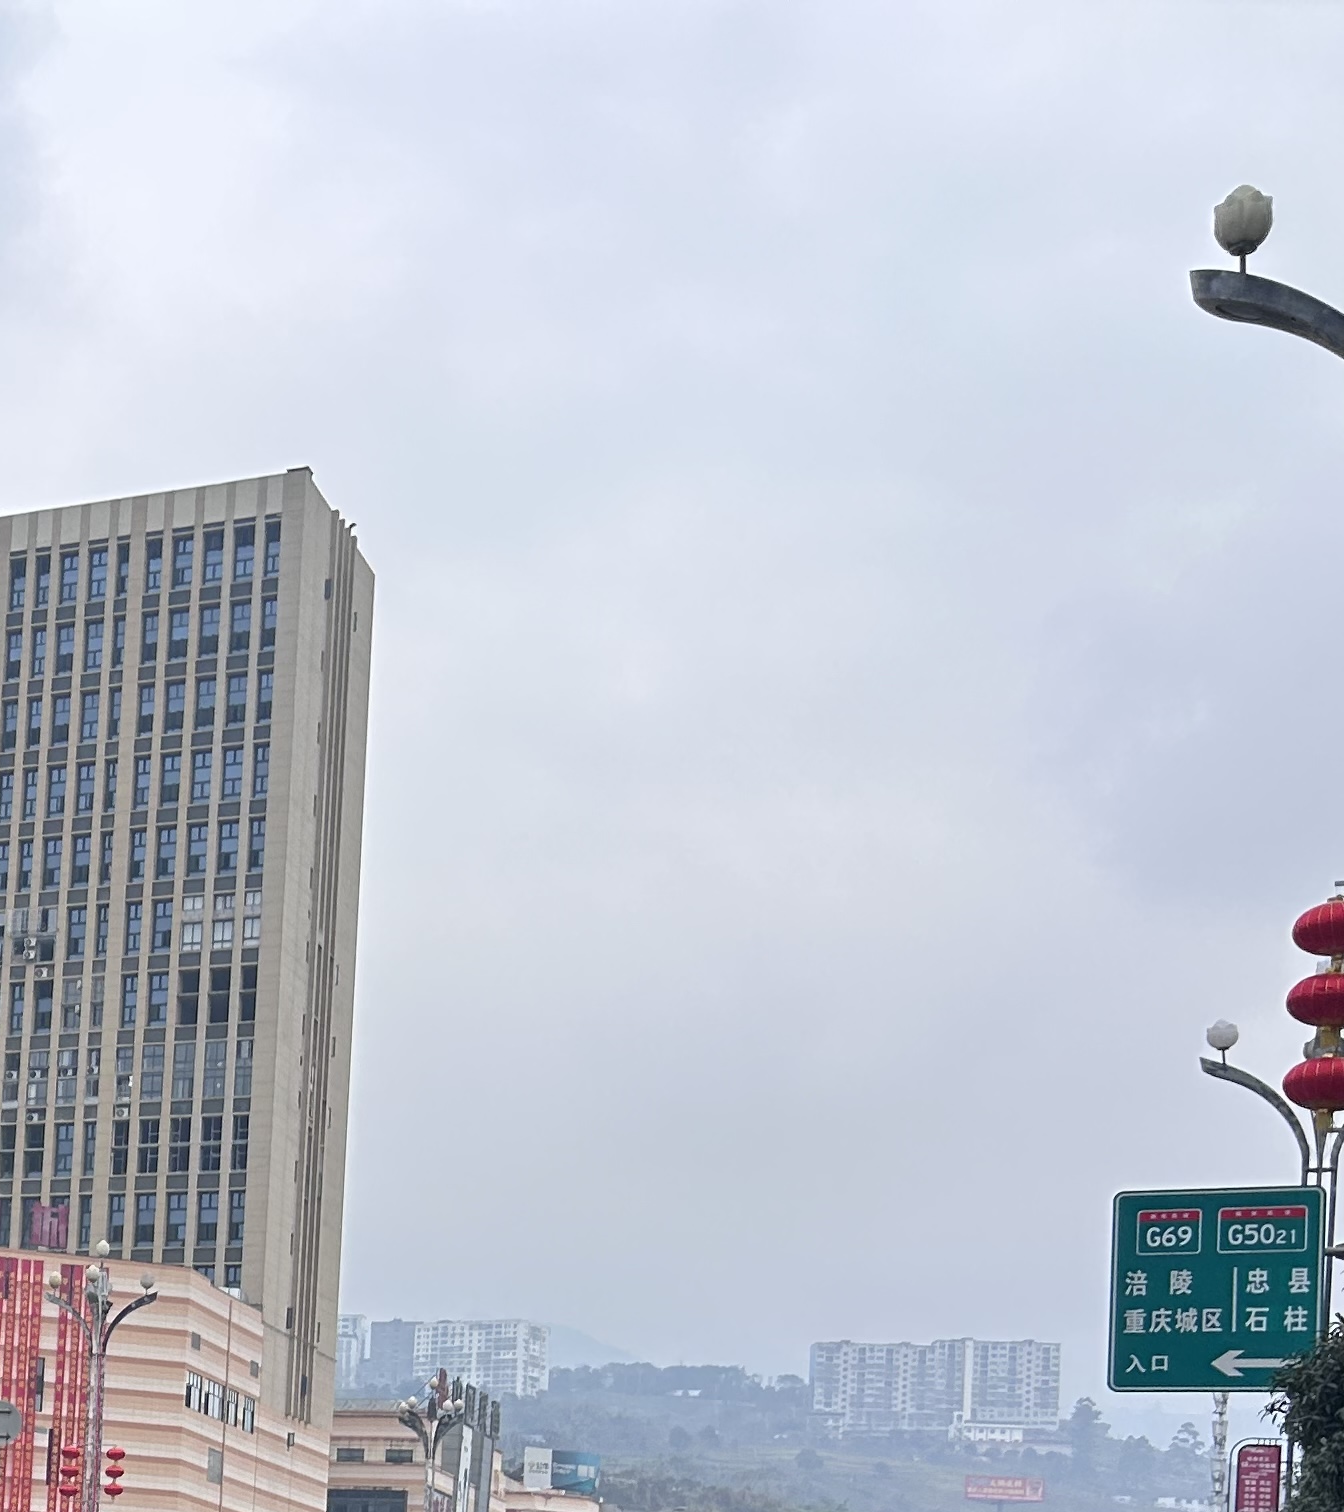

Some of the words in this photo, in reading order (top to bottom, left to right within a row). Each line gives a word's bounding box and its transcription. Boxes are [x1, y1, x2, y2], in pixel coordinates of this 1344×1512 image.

[1146, 1225, 1192, 1247] G69
[1228, 1223, 1296, 1245] G5021
[1125, 1269, 1192, 1296] 涪陵
[1246, 1267, 1311, 1294] 忠县
[1123, 1307, 1223, 1333] 重庆城区
[1245, 1306, 1308, 1332] 石柱
[1125, 1355, 1169, 1373] 入口
